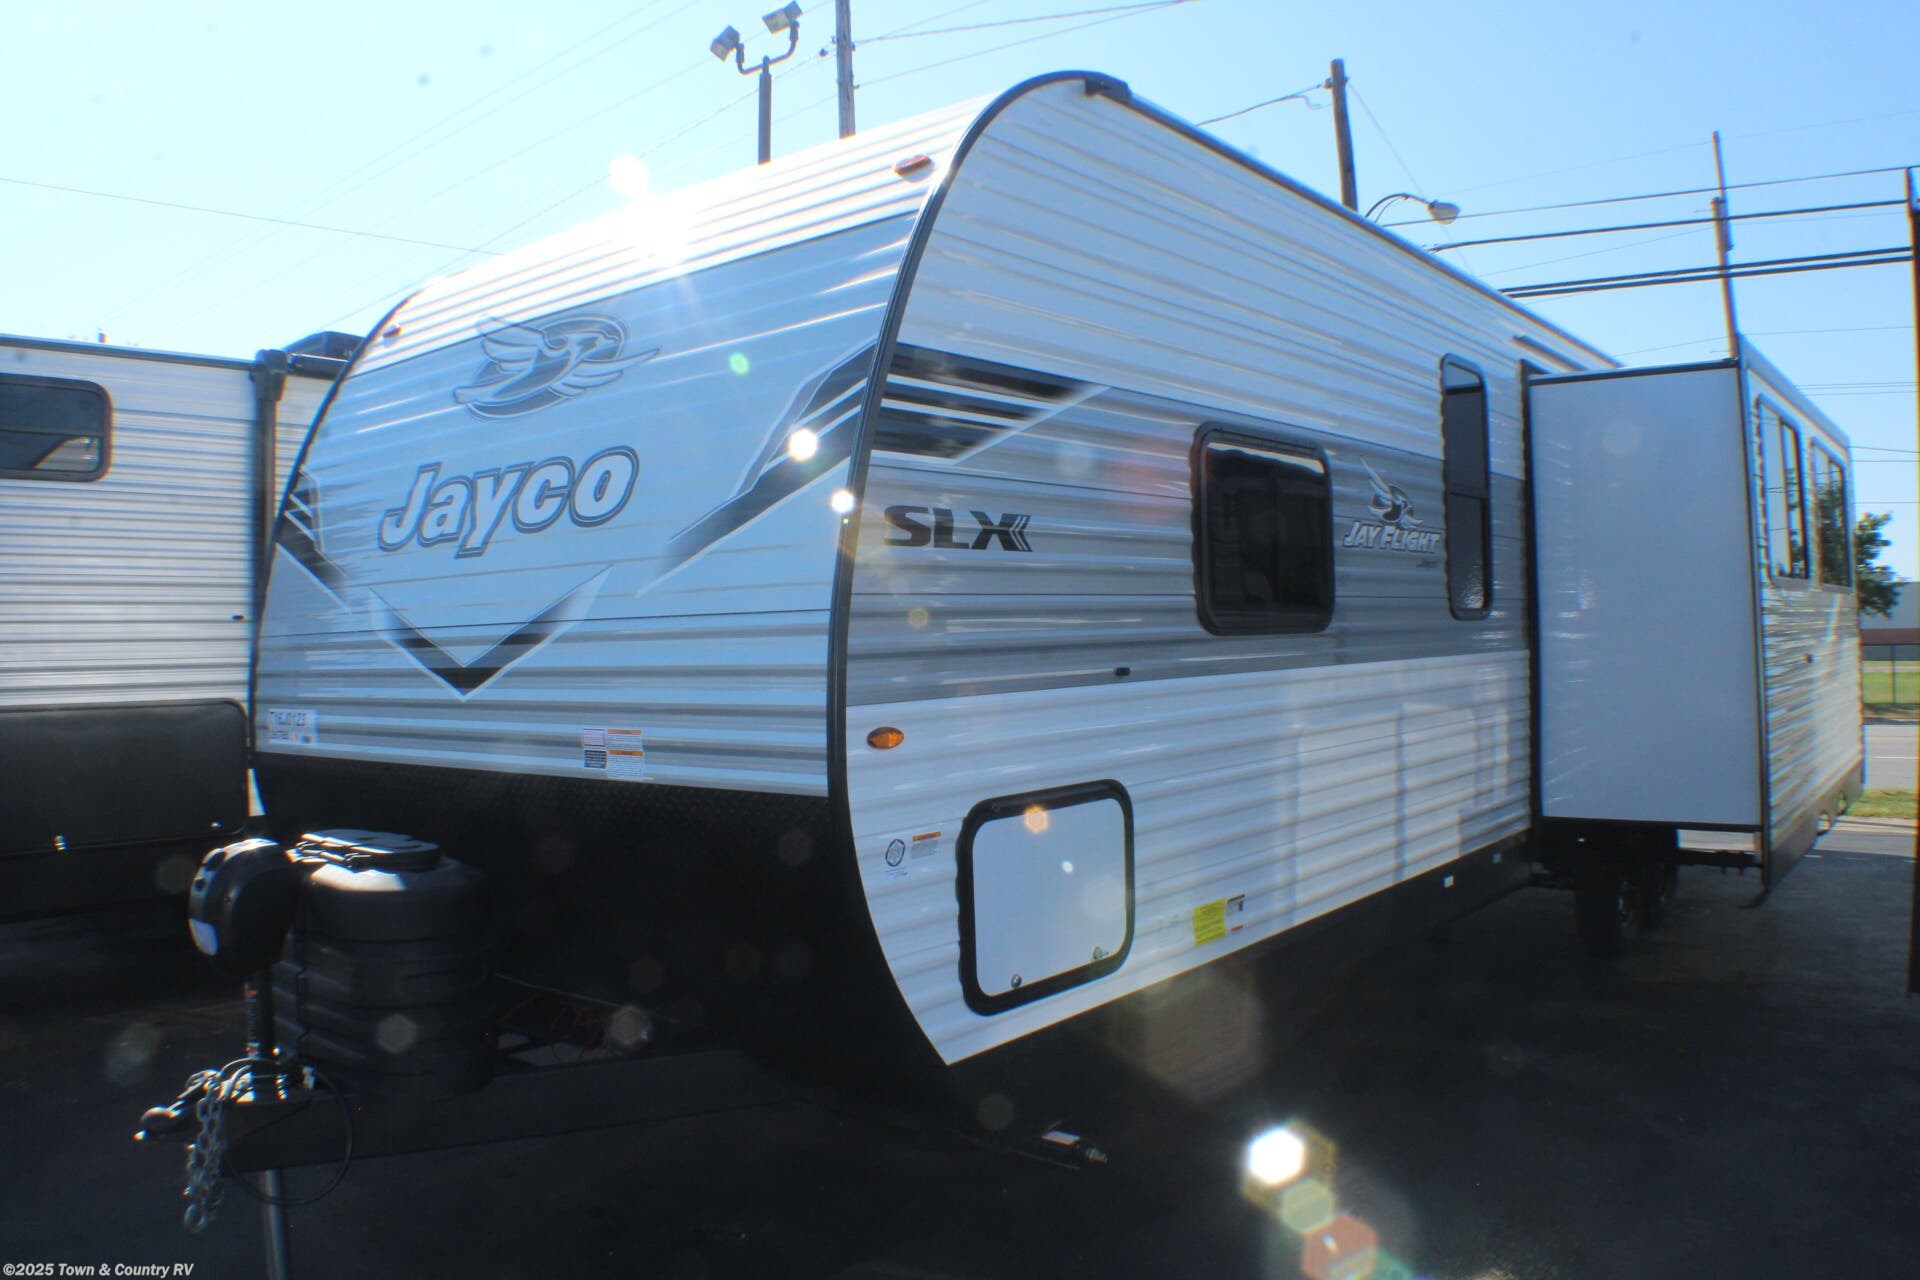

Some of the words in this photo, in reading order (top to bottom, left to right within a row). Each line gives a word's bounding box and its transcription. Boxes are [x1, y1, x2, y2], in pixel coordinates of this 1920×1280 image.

[378, 445, 640, 560] Jayco
[883, 505, 1033, 552] SLX
[1342, 520, 1382, 549] JAY
[1379, 525, 1441, 554] FLIGHT
